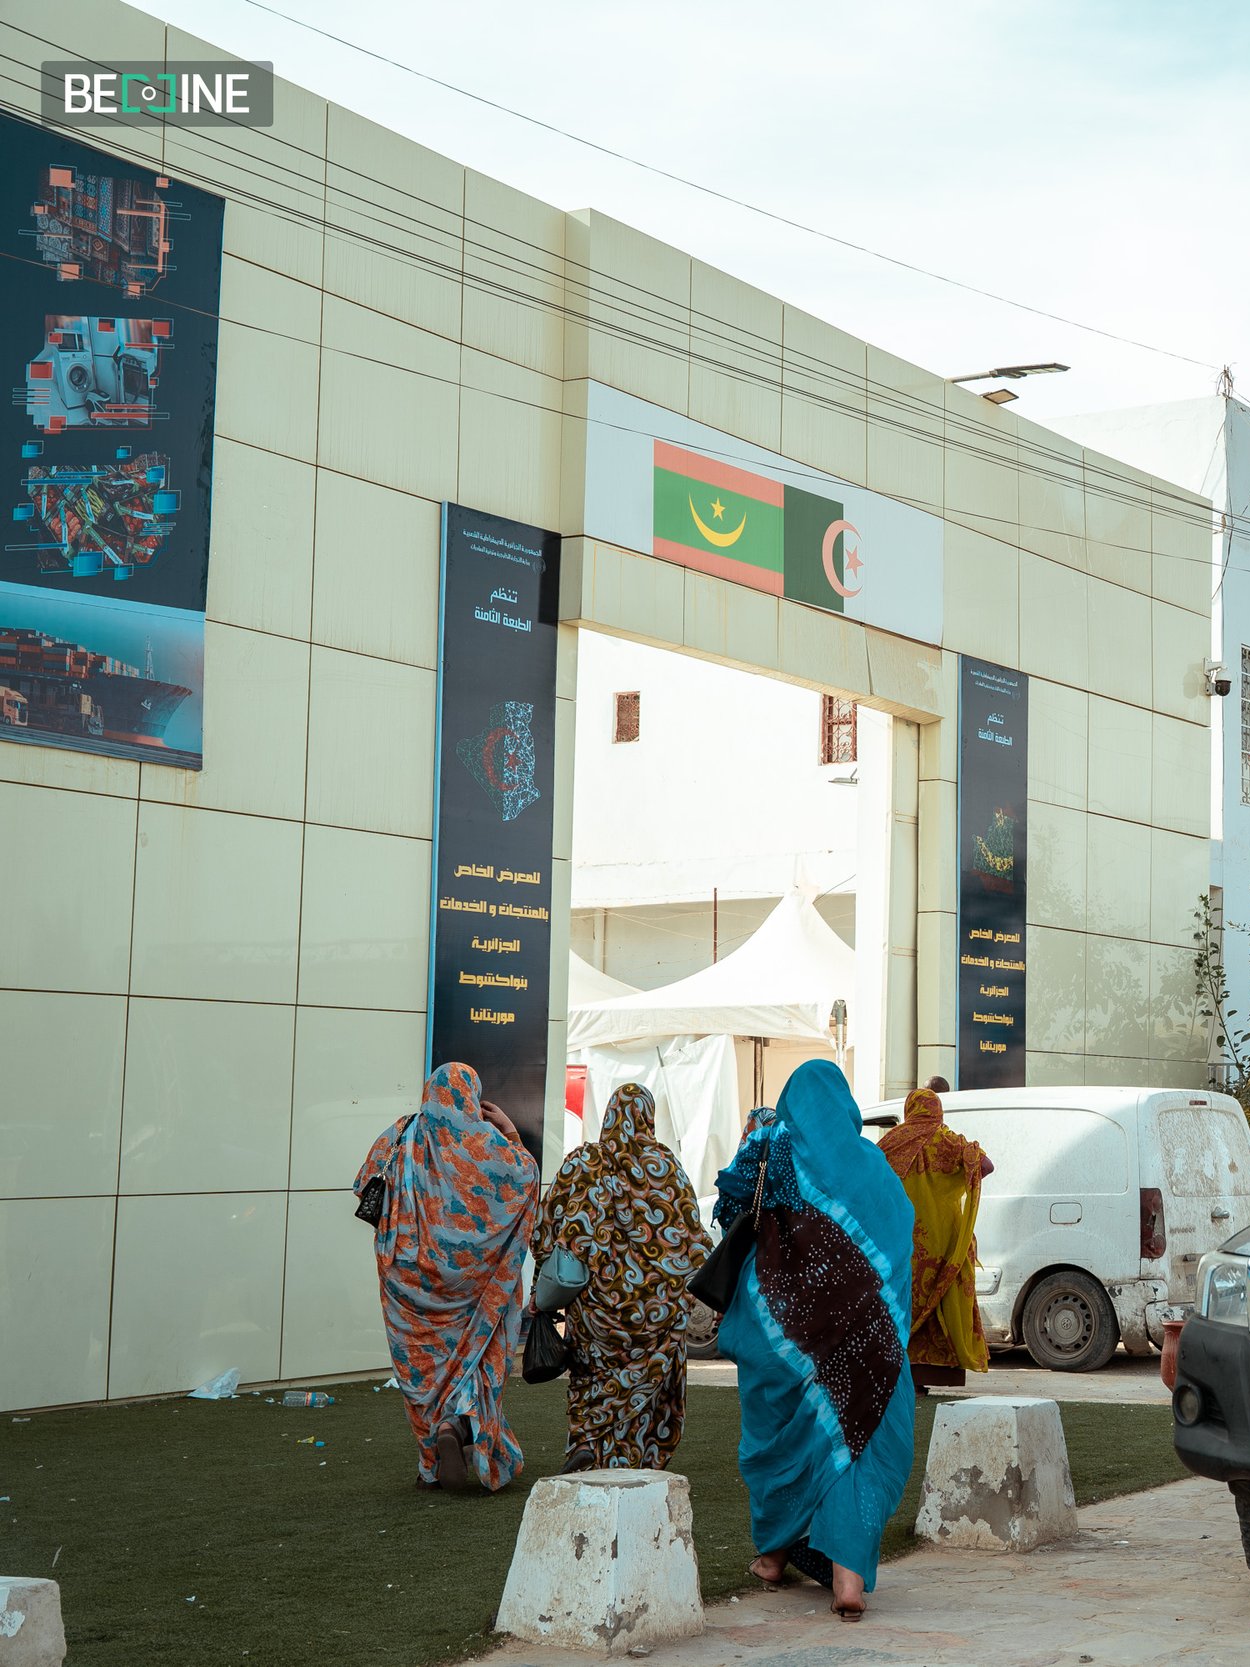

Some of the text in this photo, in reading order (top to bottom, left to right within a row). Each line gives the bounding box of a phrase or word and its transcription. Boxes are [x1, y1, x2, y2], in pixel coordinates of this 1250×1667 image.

[490, 588, 517, 603] تنظم
[475, 606, 531, 632] الطبعة الثامنة
[454, 864, 540, 884] للمعرض الخاص
[440, 897, 548, 922] بالمنتجات و الخدمات
[969, 928, 992, 940] الخاص
[472, 936, 520, 954] الجزائرية
[459, 971, 528, 990] بنواكشوط
[470, 1008, 515, 1024] موريتانيا
